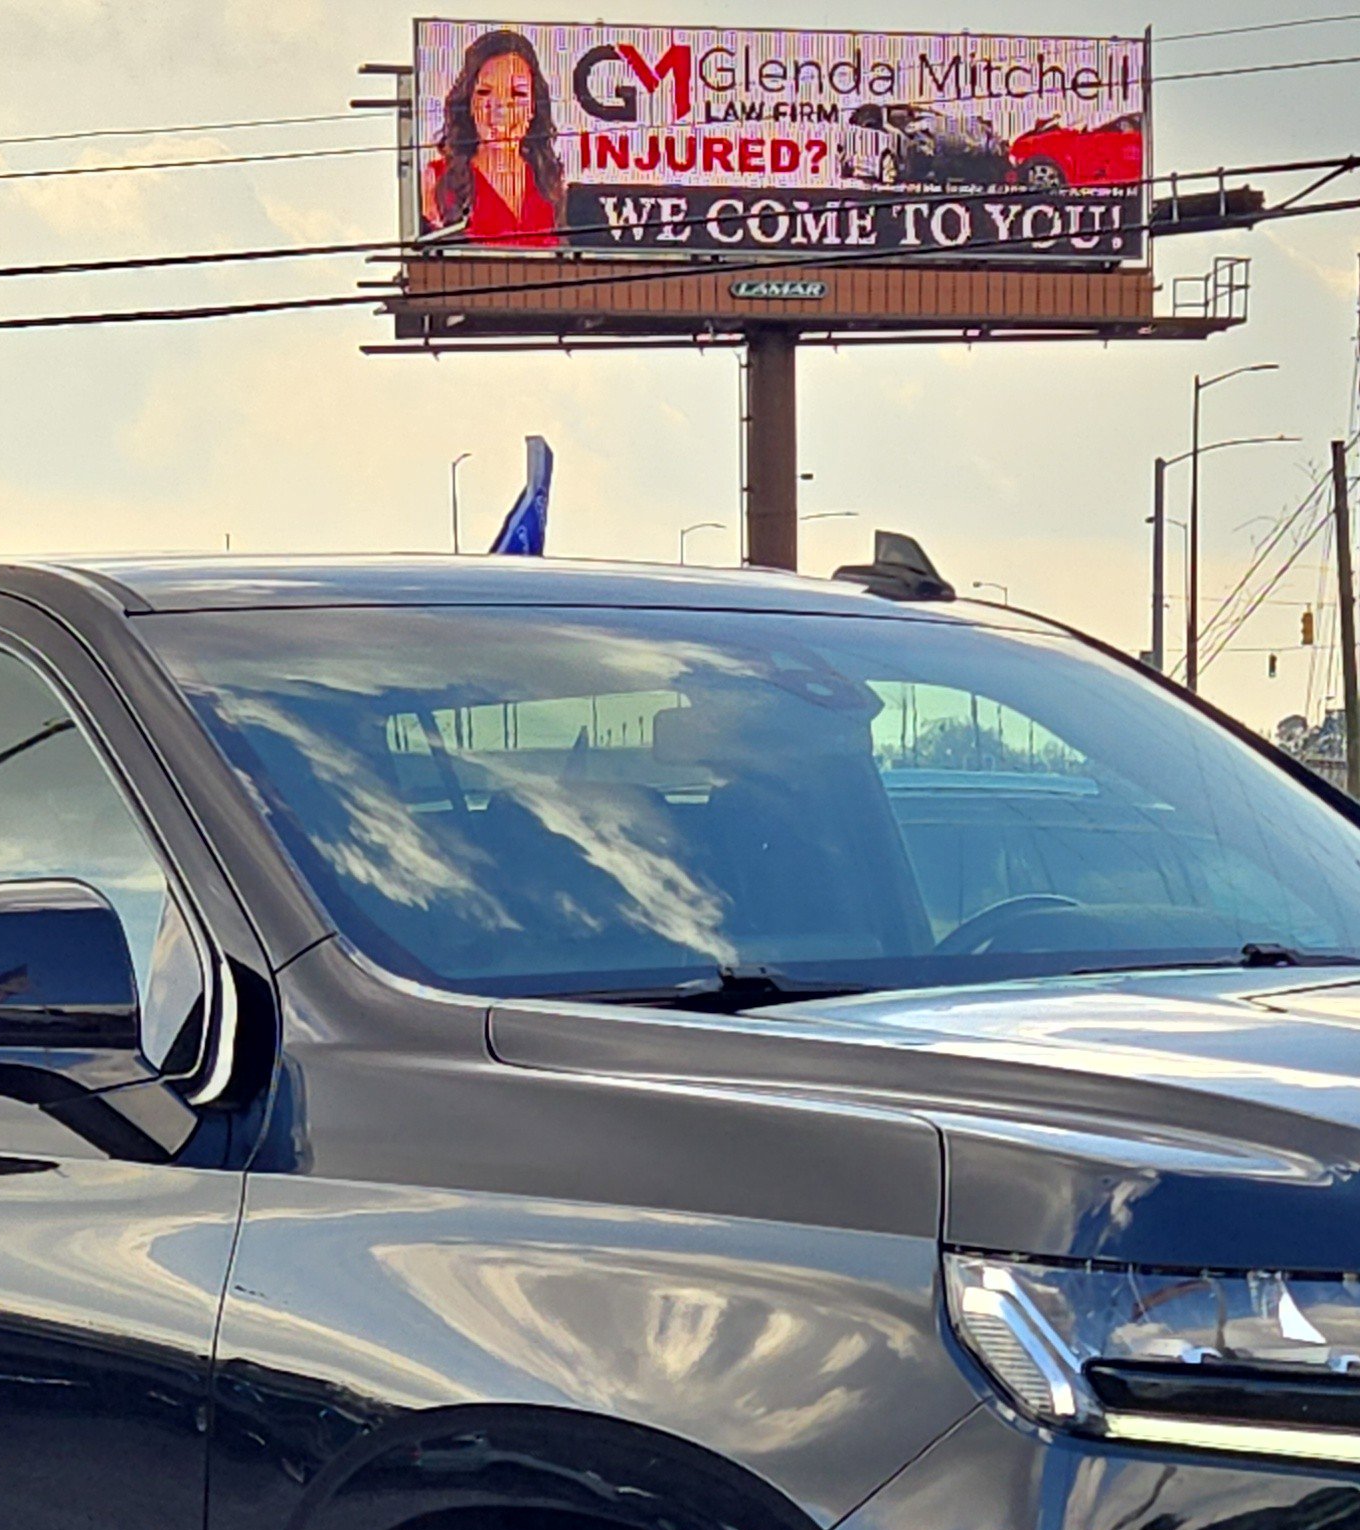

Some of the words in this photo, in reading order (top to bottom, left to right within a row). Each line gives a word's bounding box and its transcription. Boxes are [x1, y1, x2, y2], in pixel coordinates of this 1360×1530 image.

[573, 43, 691, 122] GM
[699, 45, 896, 95] Glenda
[919, 53, 1130, 101] Mitchell
[705, 101, 765, 123] LAW
[773, 101, 840, 124] FIRM
[580, 131, 828, 174] INJURED?
[599, 197, 692, 243] WE
[706, 199, 878, 246] COME
[892, 203, 972, 248] TO
[984, 204, 1123, 249] YOU!
[737, 281, 823, 298] LAMAR
